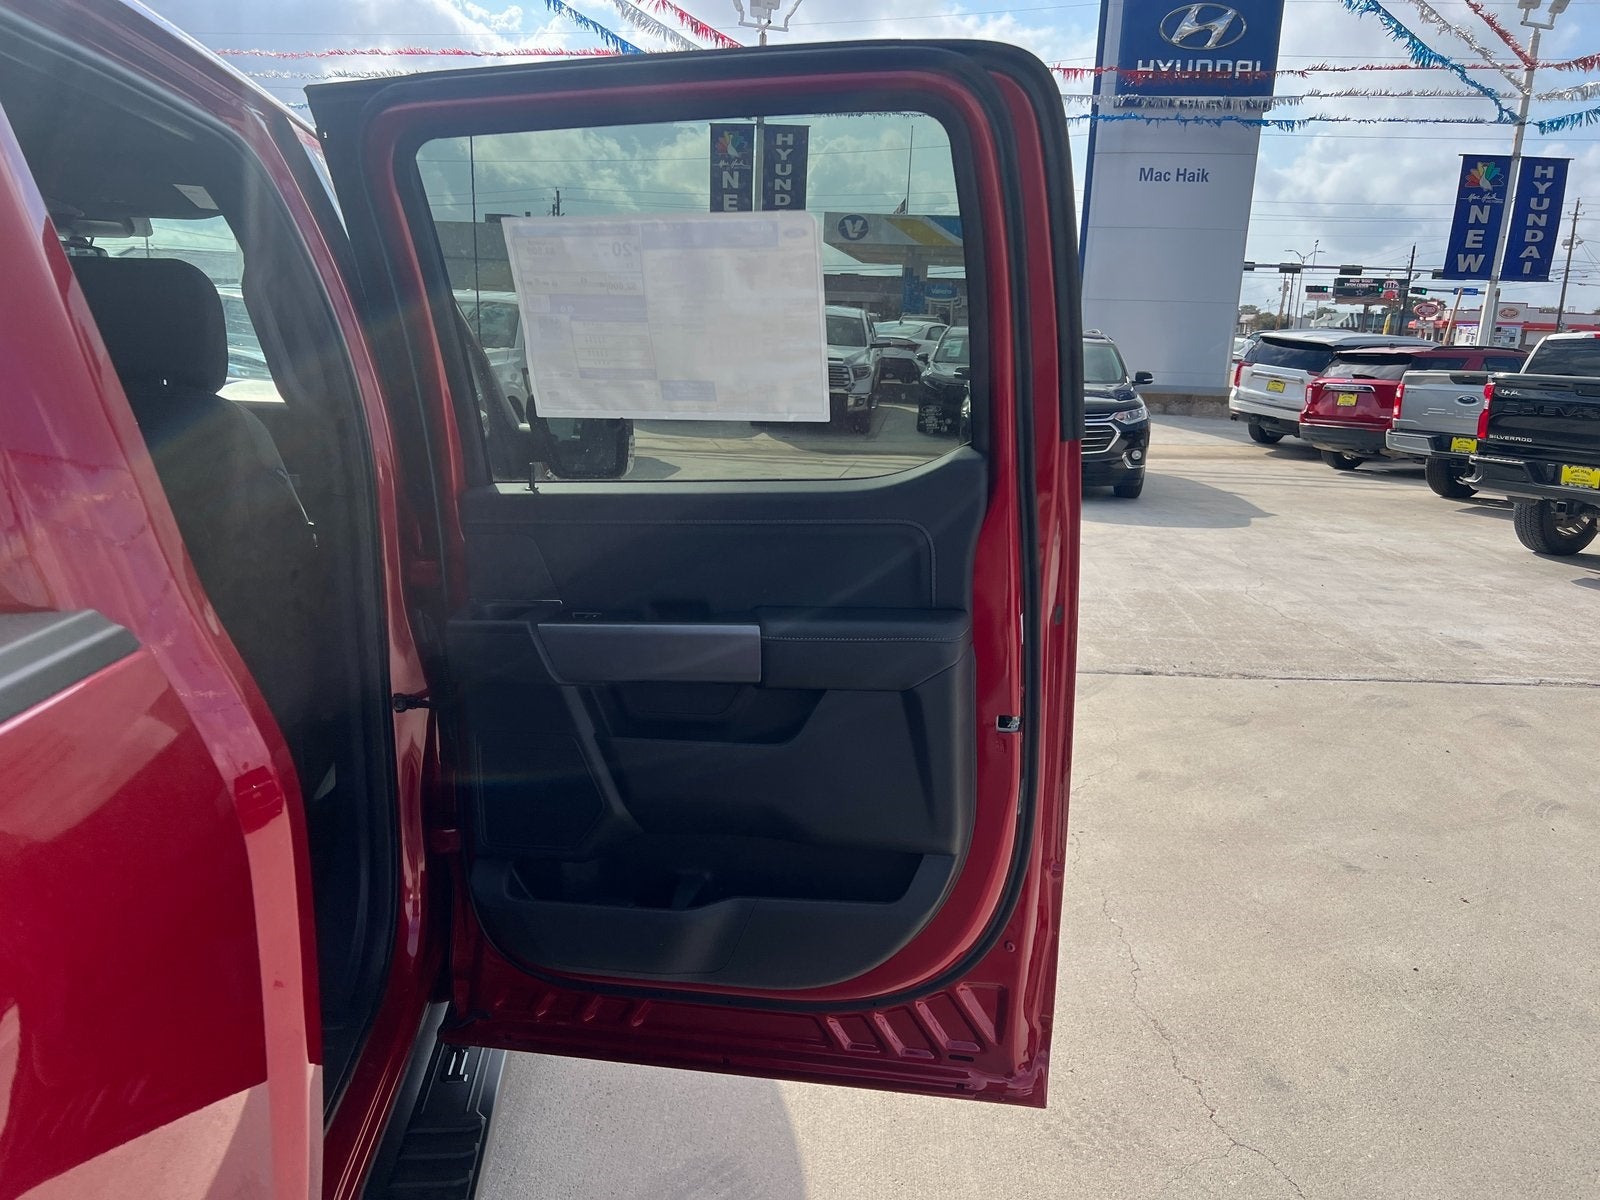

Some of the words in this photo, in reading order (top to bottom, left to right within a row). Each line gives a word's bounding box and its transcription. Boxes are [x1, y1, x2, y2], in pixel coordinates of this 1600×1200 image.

[1136, 59, 1262, 80] HYUNDAI
[774, 133, 794, 206] HYUND
[1138, 167, 1171, 182] Mac
[1175, 167, 1209, 182] Haik
[722, 170, 739, 211] NE
[1457, 204, 1491, 273] NEW
[1519, 165, 1555, 274] HYUNDAI
[1488, 433, 1533, 443] SILVERADO
